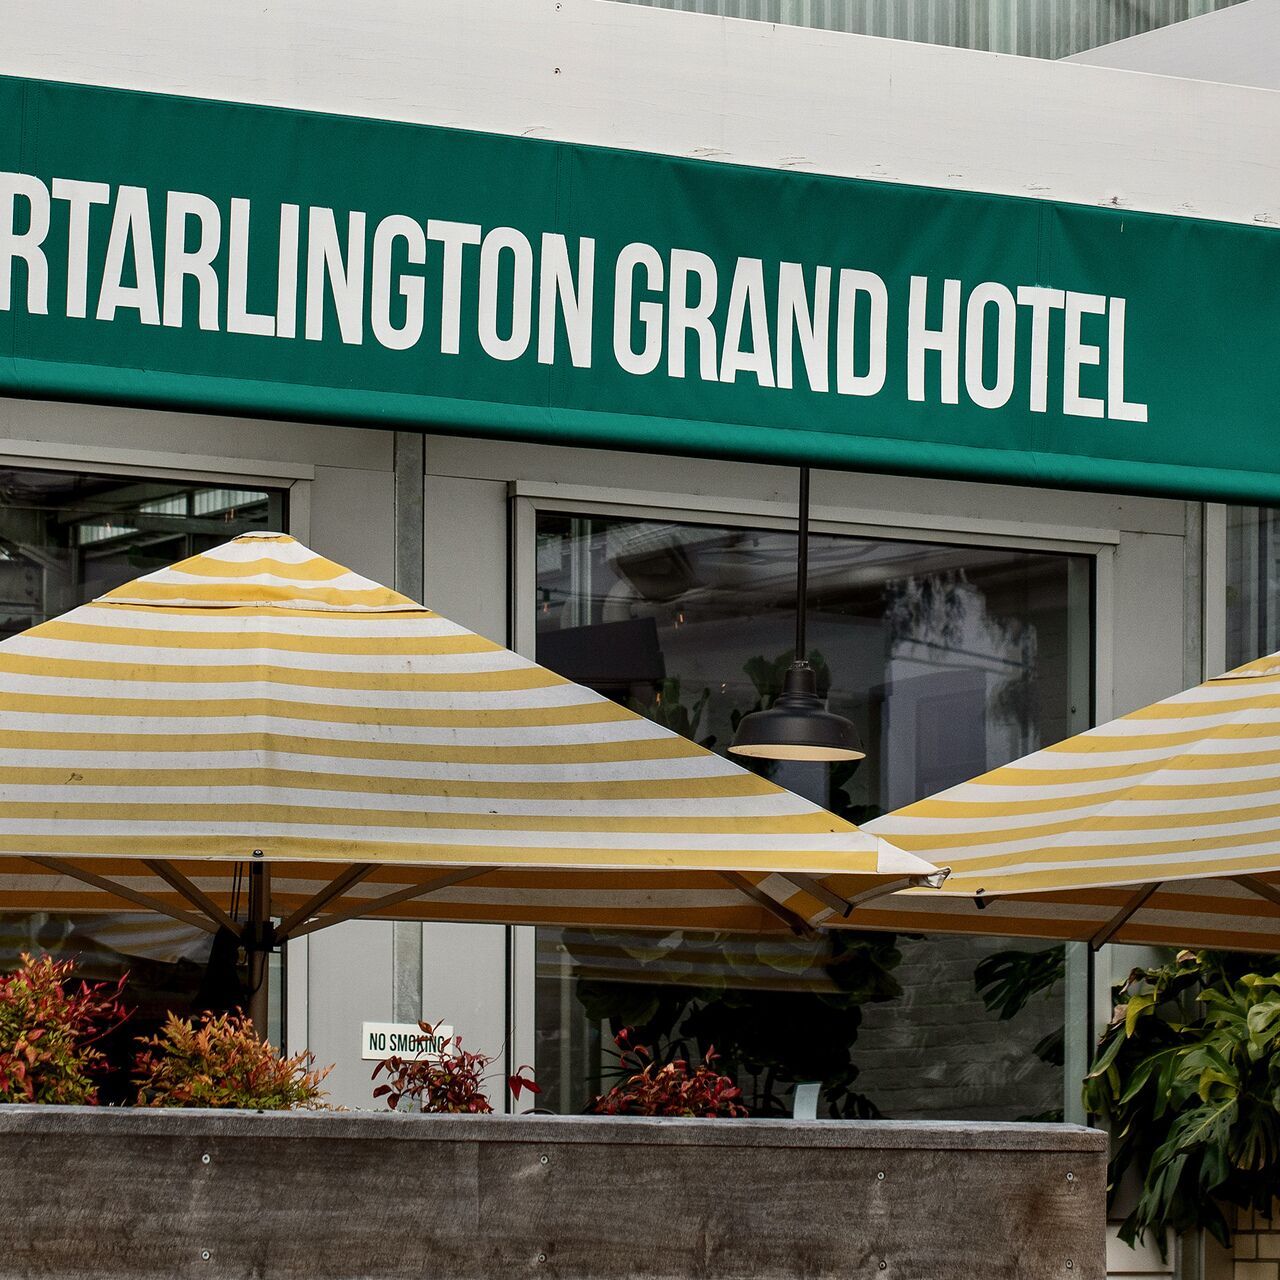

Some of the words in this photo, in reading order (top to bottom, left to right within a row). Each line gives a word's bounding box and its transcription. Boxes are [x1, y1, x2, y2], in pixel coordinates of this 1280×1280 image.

[613, 242, 889, 398] GRAND
[907, 275, 1149, 424] HOTEL
[370, 1033, 386, 1051] NO
